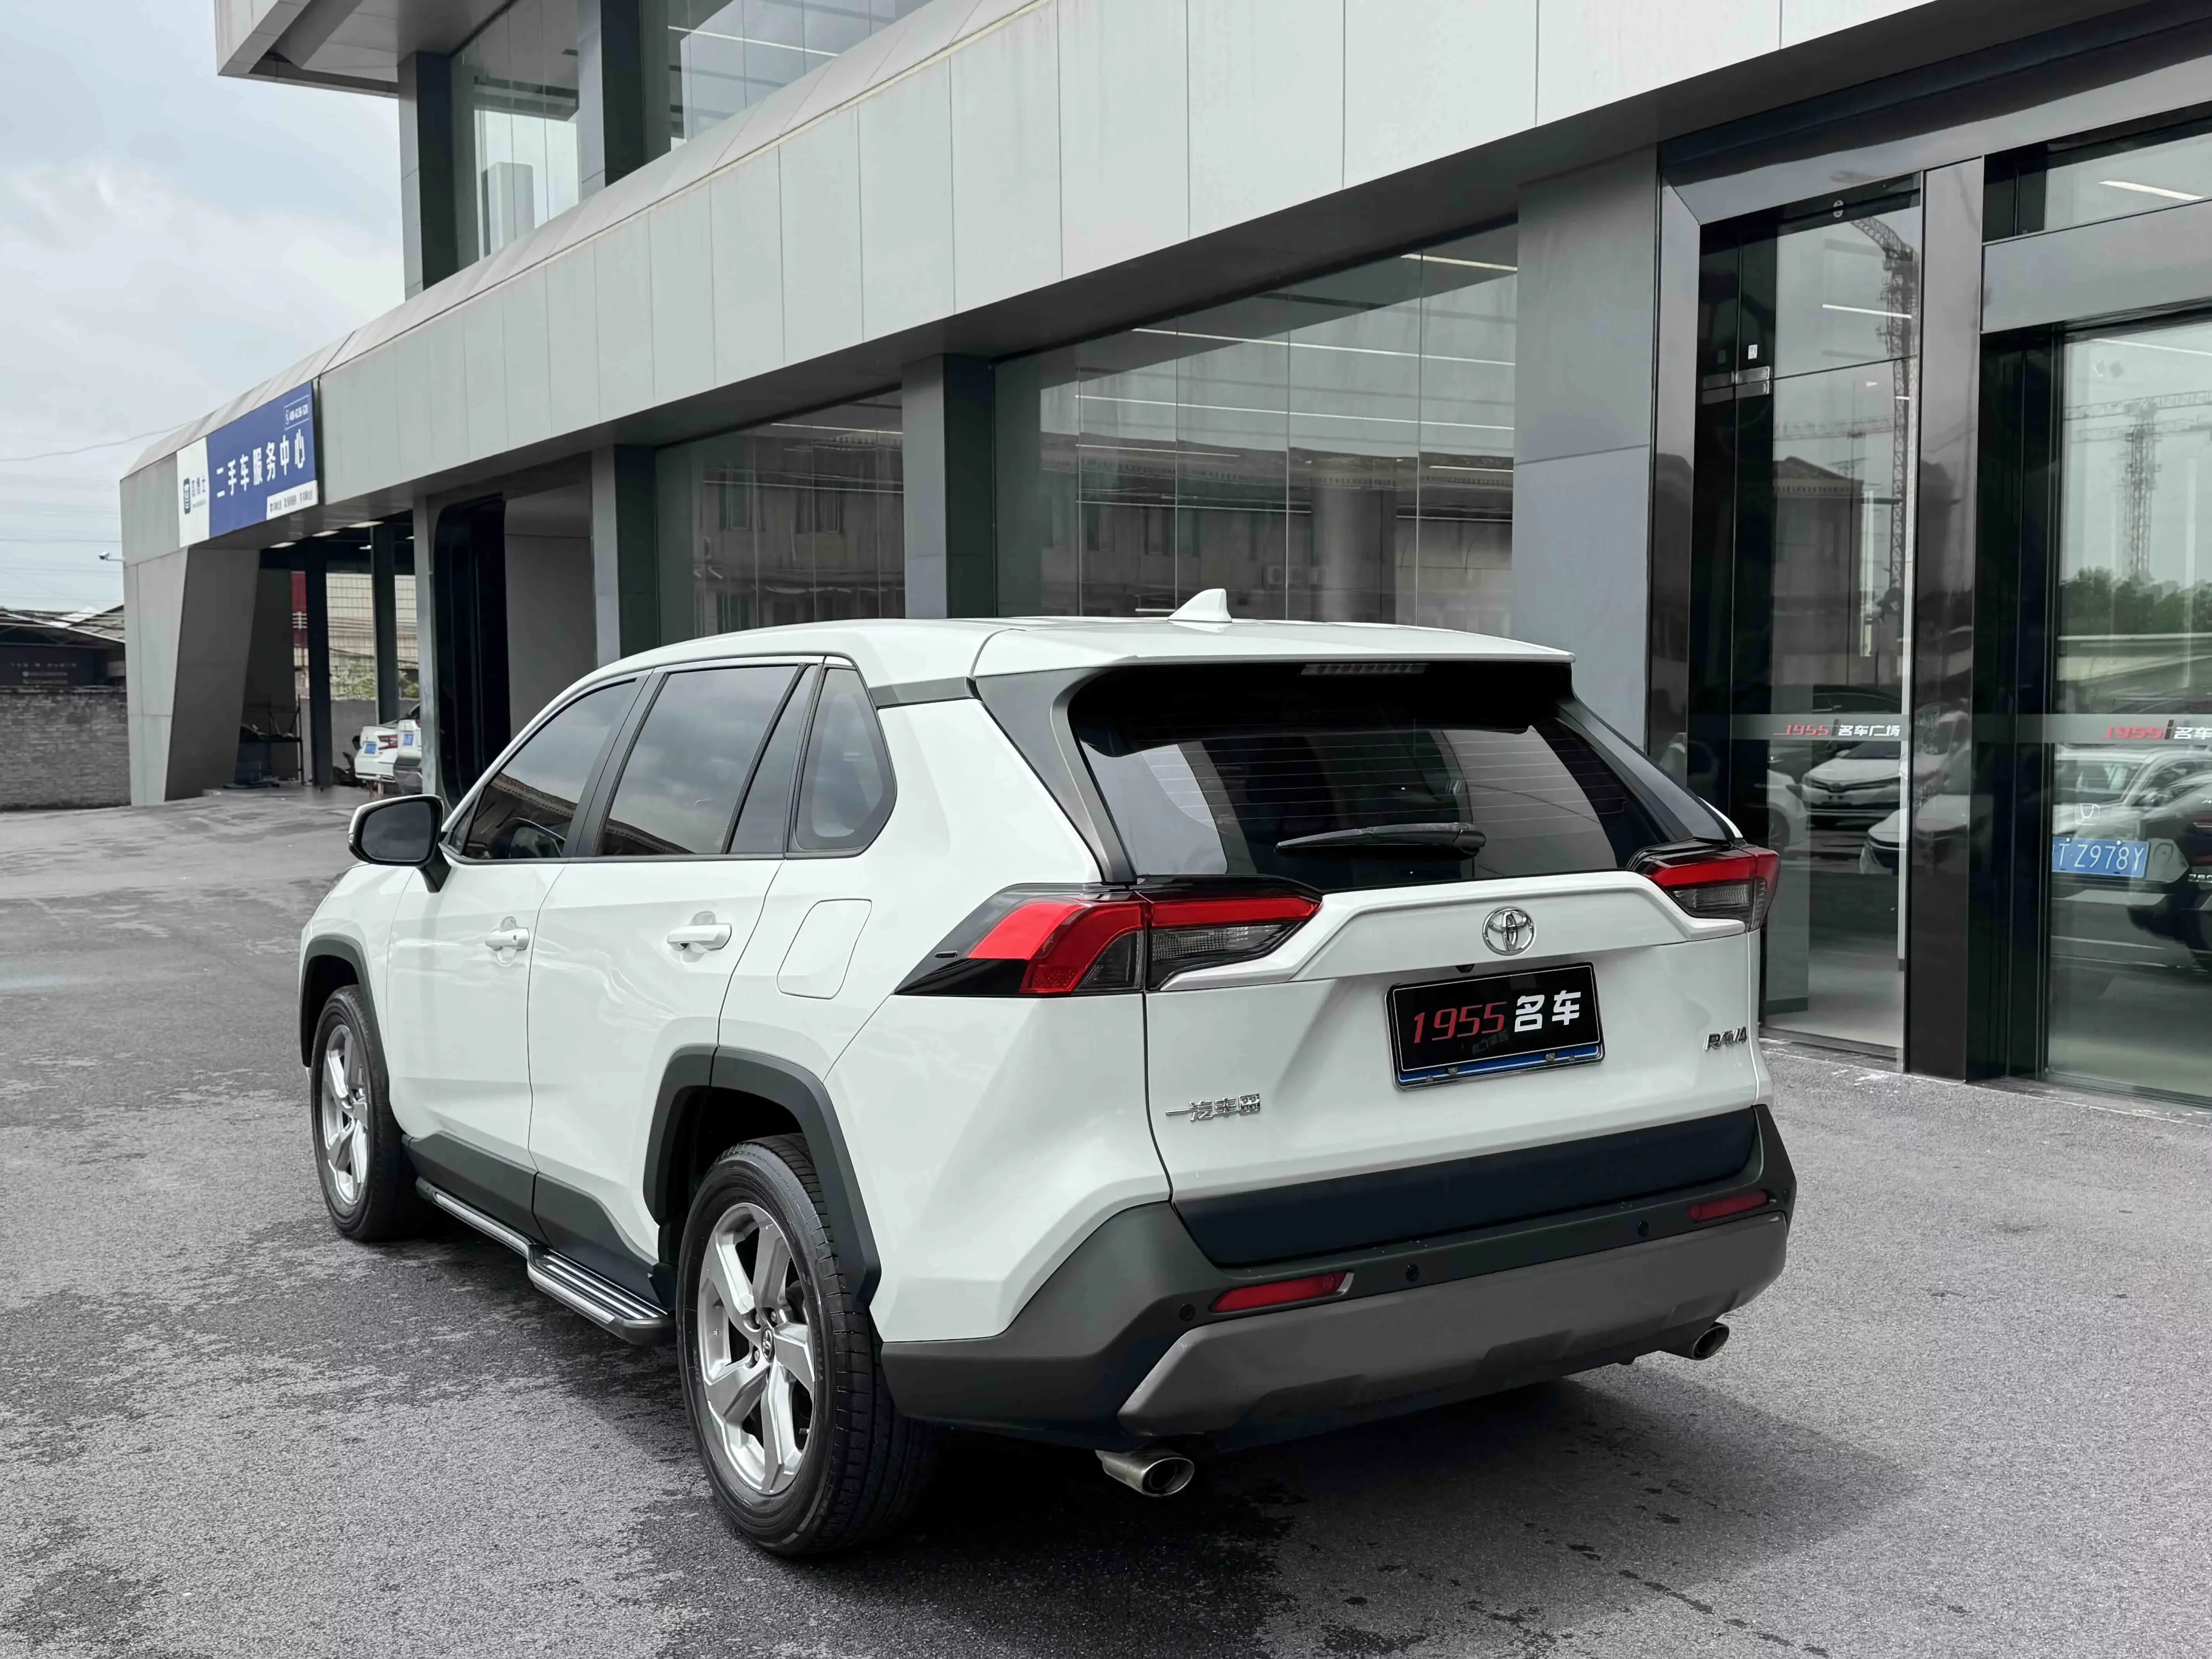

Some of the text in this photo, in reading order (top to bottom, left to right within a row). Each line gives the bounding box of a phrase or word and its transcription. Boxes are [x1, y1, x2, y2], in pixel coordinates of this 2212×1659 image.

[216, 428, 306, 498] 二手车服务中心
[1783, 725, 1901, 736] 1955 名车广场
[2106, 726, 2163, 739] 1955
[1413, 1001, 1507, 1043] 1955
[1514, 990, 1582, 1032] 名车
[1704, 1026, 1747, 1051] RAV4
[1165, 1093, 1261, 1122] 一汽丰田
